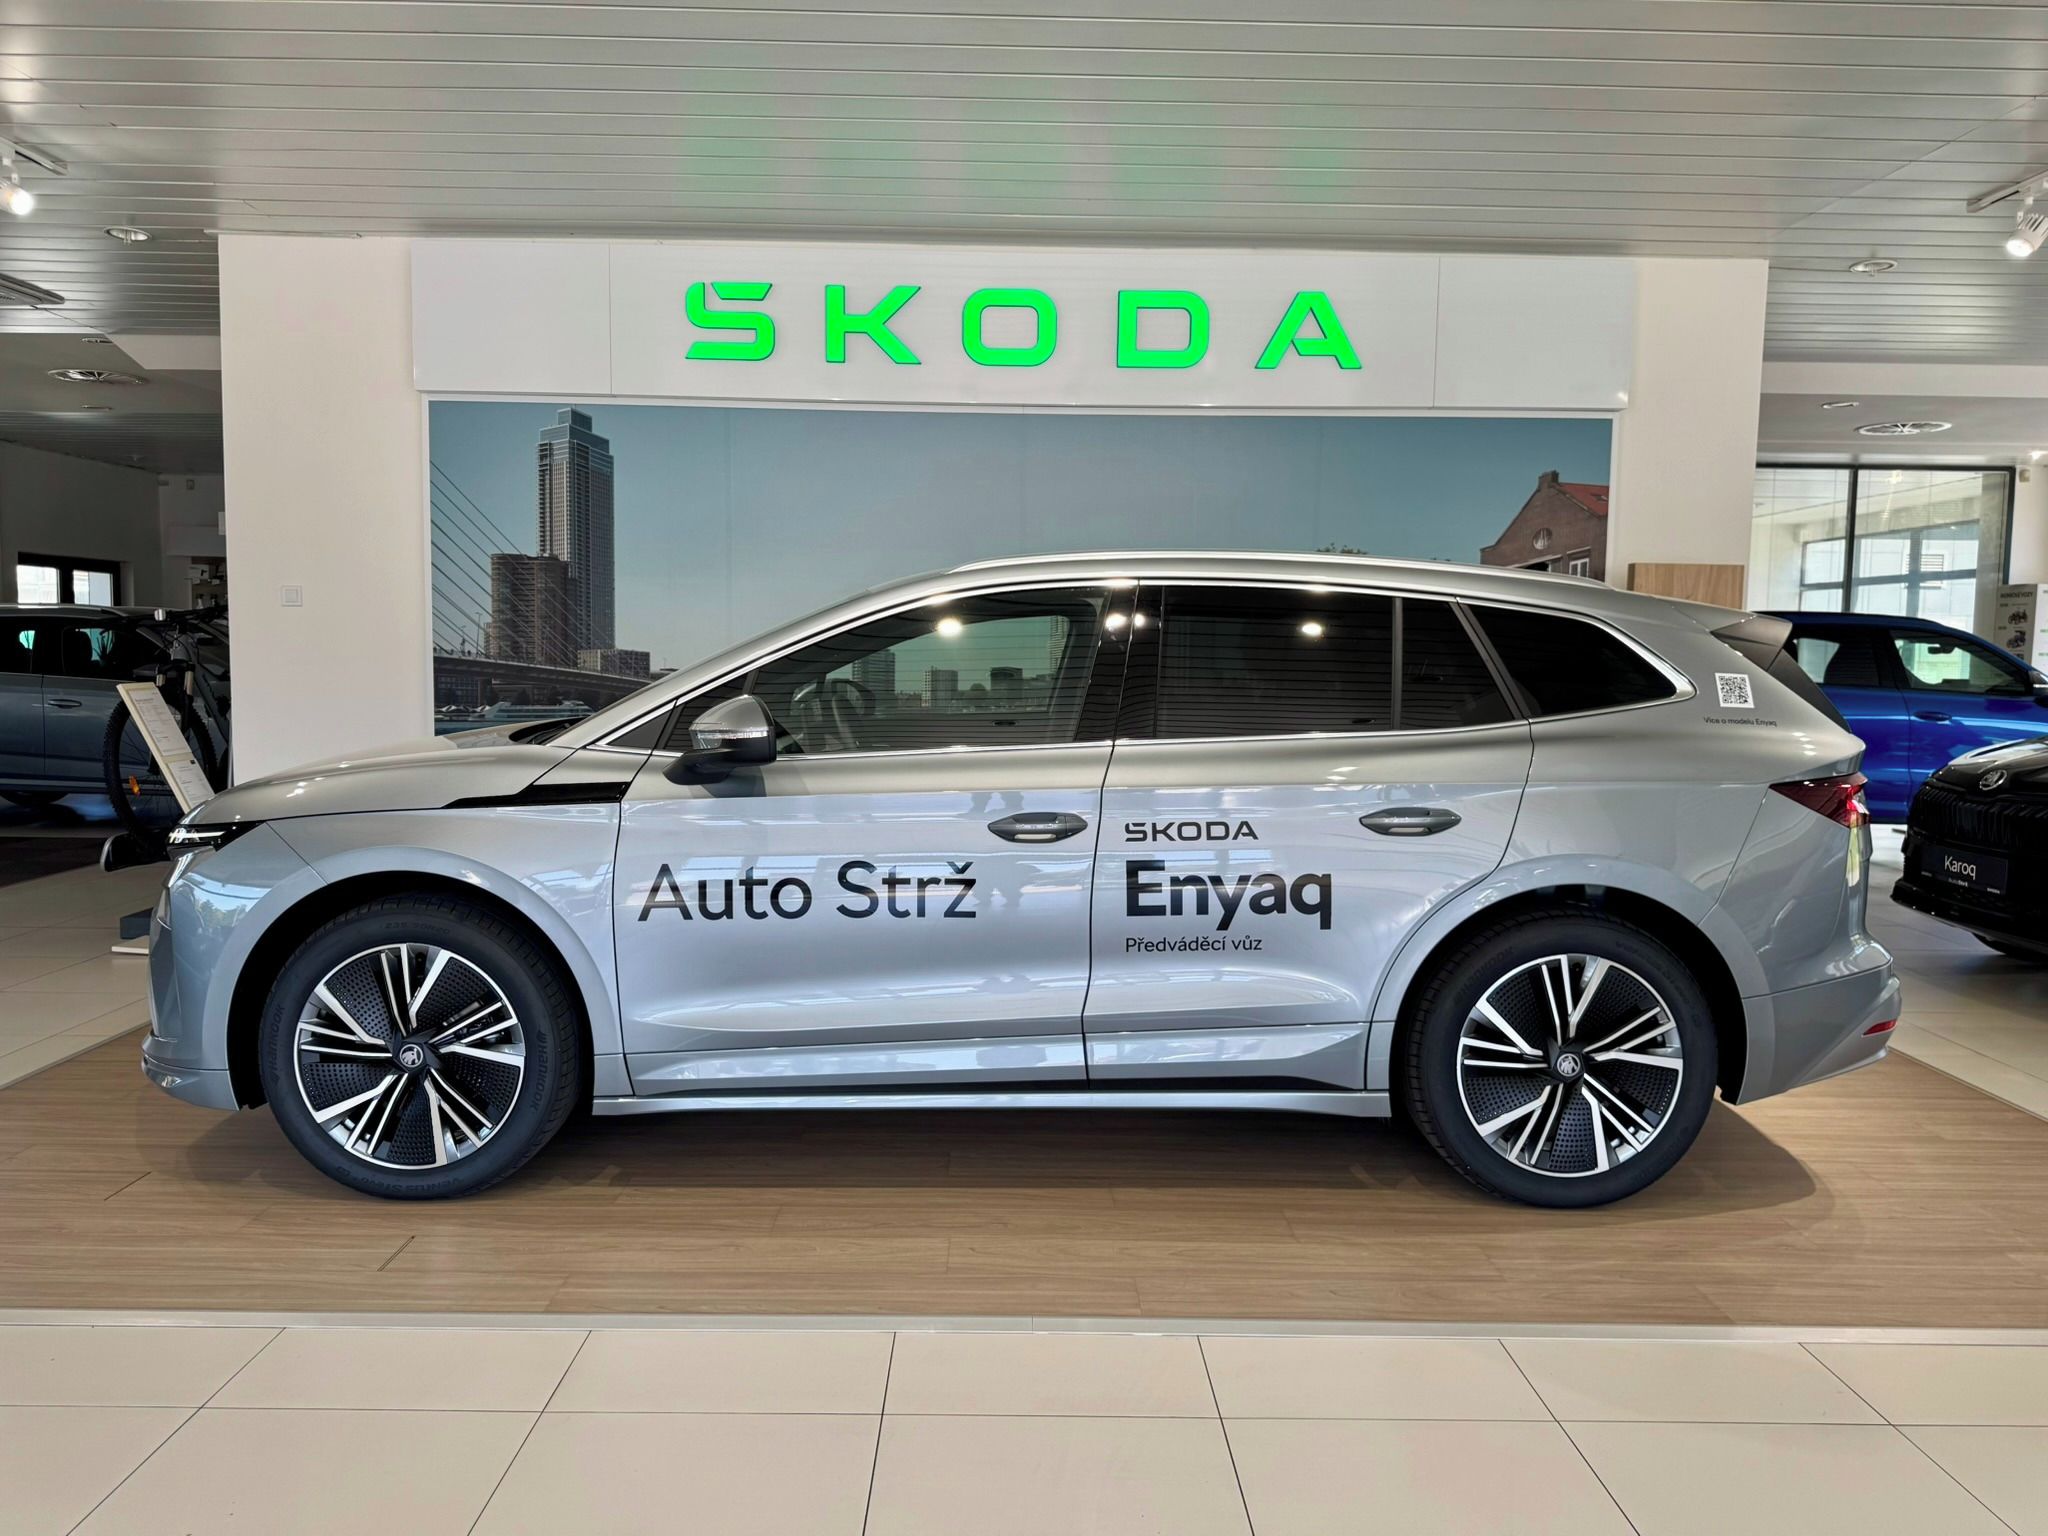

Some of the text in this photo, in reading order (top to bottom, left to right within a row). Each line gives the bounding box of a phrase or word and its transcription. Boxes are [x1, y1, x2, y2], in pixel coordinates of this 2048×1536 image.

[1755, 718, 1777, 727] Enyaq
[1944, 855, 1976, 880] Karoq
[638, 860, 977, 921] Auto Strž
[1126, 860, 1332, 931] Enyaq
[1126, 935, 1262, 952] Předváděcí vůz
